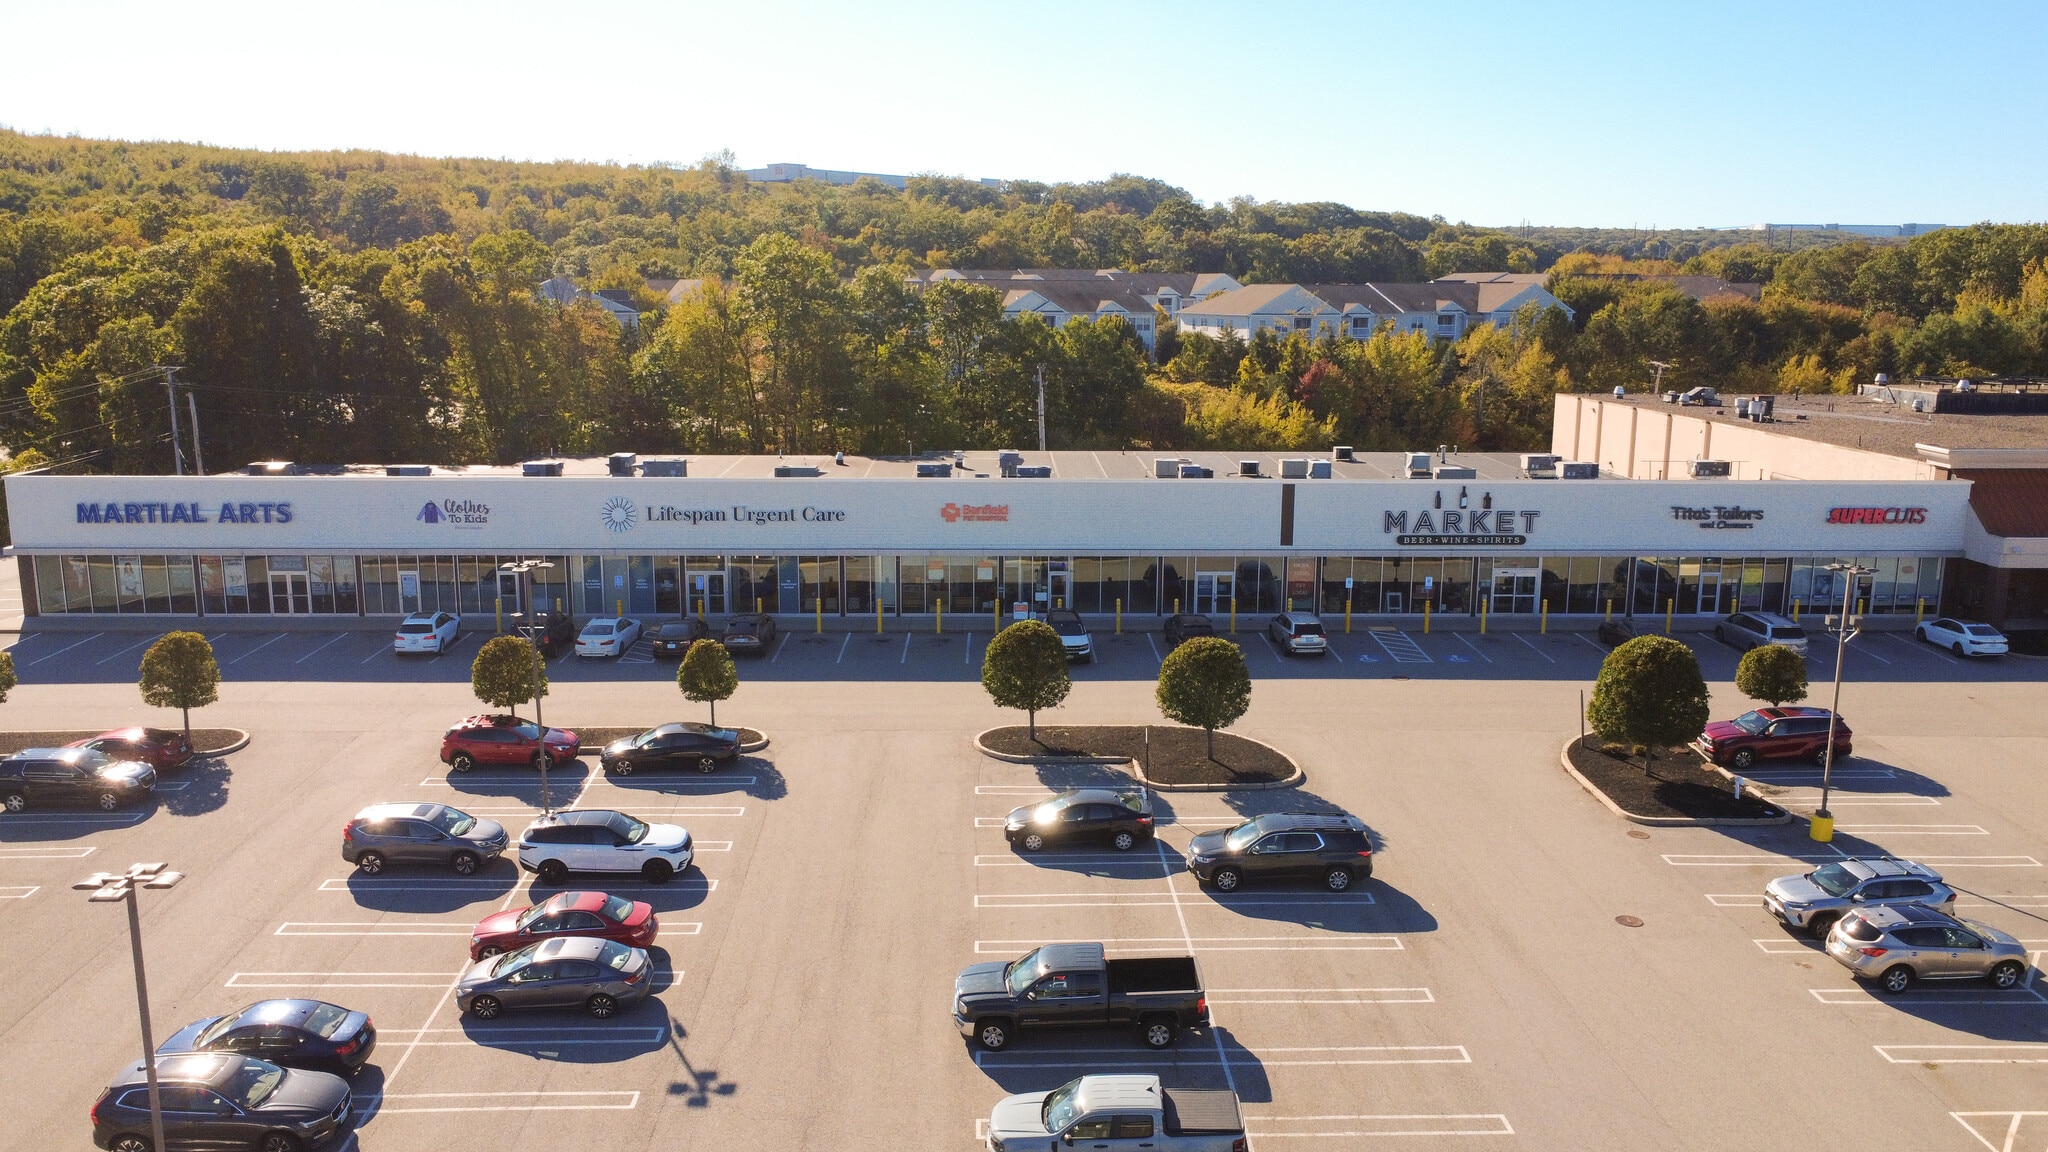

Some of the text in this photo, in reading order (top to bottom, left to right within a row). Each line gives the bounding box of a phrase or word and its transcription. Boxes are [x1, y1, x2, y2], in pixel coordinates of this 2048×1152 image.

[76, 502, 293, 525] MARTIAL ARTS
[444, 499, 491, 515] Clothes
[1713, 506, 1764, 520] Tailors
[448, 514, 488, 523] To Kids
[646, 506, 846, 526] Lifespan Urgent Care
[1384, 510, 1541, 534] MARKET
[1826, 507, 1929, 524] SUPERCUTS
[1403, 536, 1521, 544] BEER WINE SPIRITS
